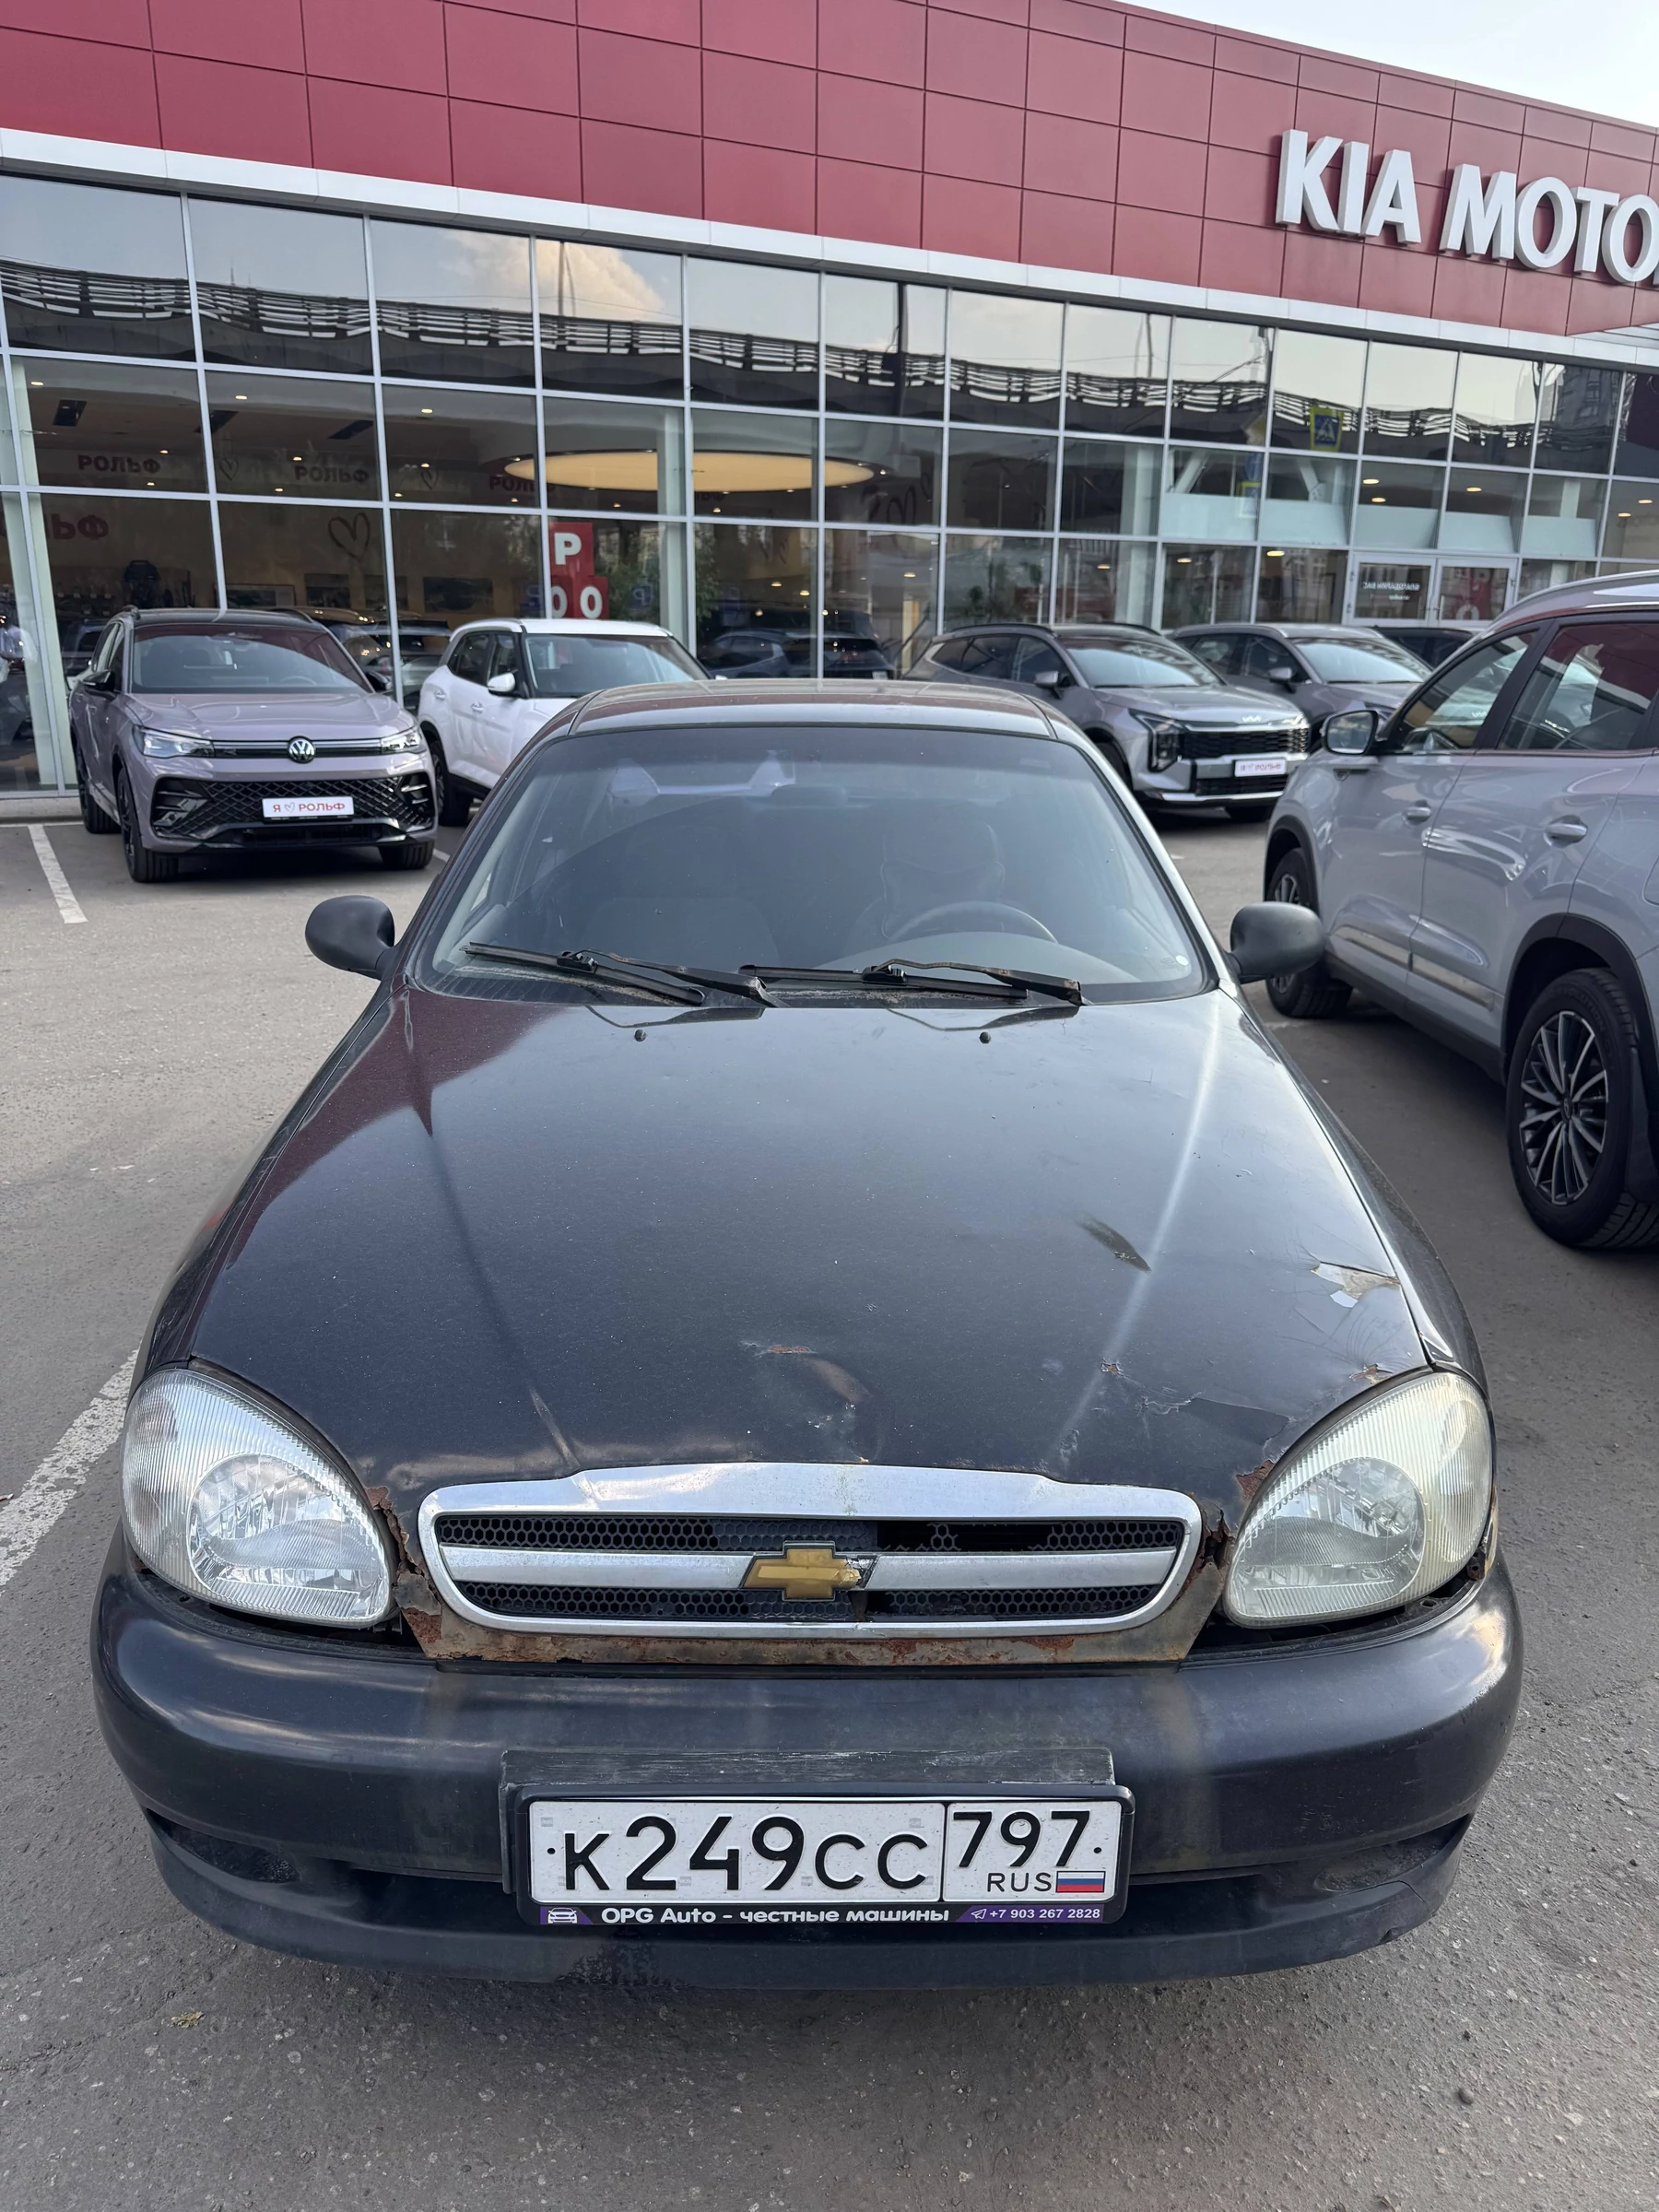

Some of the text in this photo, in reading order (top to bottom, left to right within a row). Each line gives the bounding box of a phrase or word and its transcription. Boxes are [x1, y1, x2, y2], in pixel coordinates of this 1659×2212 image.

[1276, 129, 1659, 284] KIA MOTO
[77, 454, 161, 474] РОЛЬФ
[294, 465, 369, 484] РОЛЬФ
[273, 803, 345, 812] Я РОЛЬФ
[565, 1811, 1089, 1890] К249СС 797
[987, 1873, 1052, 1892] RUS
[601, 1908, 653, 1924] OPG
[660, 1908, 716, 1923] Auto
[740, 1910, 840, 1923] честные
[846, 1910, 948, 1923] машины
[990, 1909, 1100, 1919] +7 903 267 2828
